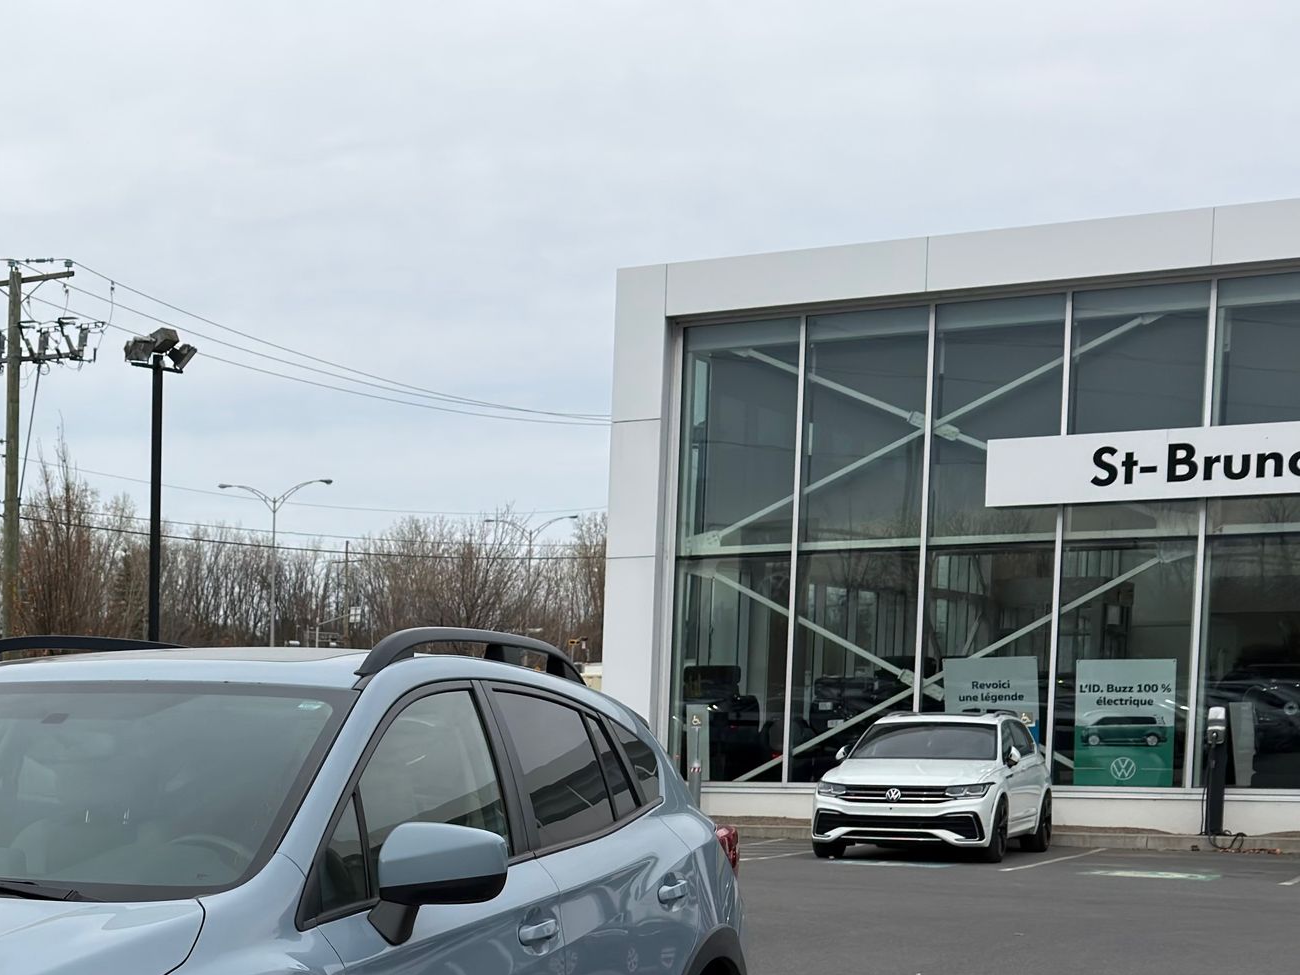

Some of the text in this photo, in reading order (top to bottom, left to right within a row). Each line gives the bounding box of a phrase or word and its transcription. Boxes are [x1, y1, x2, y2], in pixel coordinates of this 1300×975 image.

[971, 680, 1011, 690] Revoici
[1106, 683, 1134, 693] Buzz
[1137, 683, 1159, 693] 100
[1161, 683, 1172, 693] %
[958, 692, 1025, 703] une légende
[1096, 696, 1154, 708] électrique
[1110, 756, 1136, 780] VW
[886, 787, 902, 802] VW
